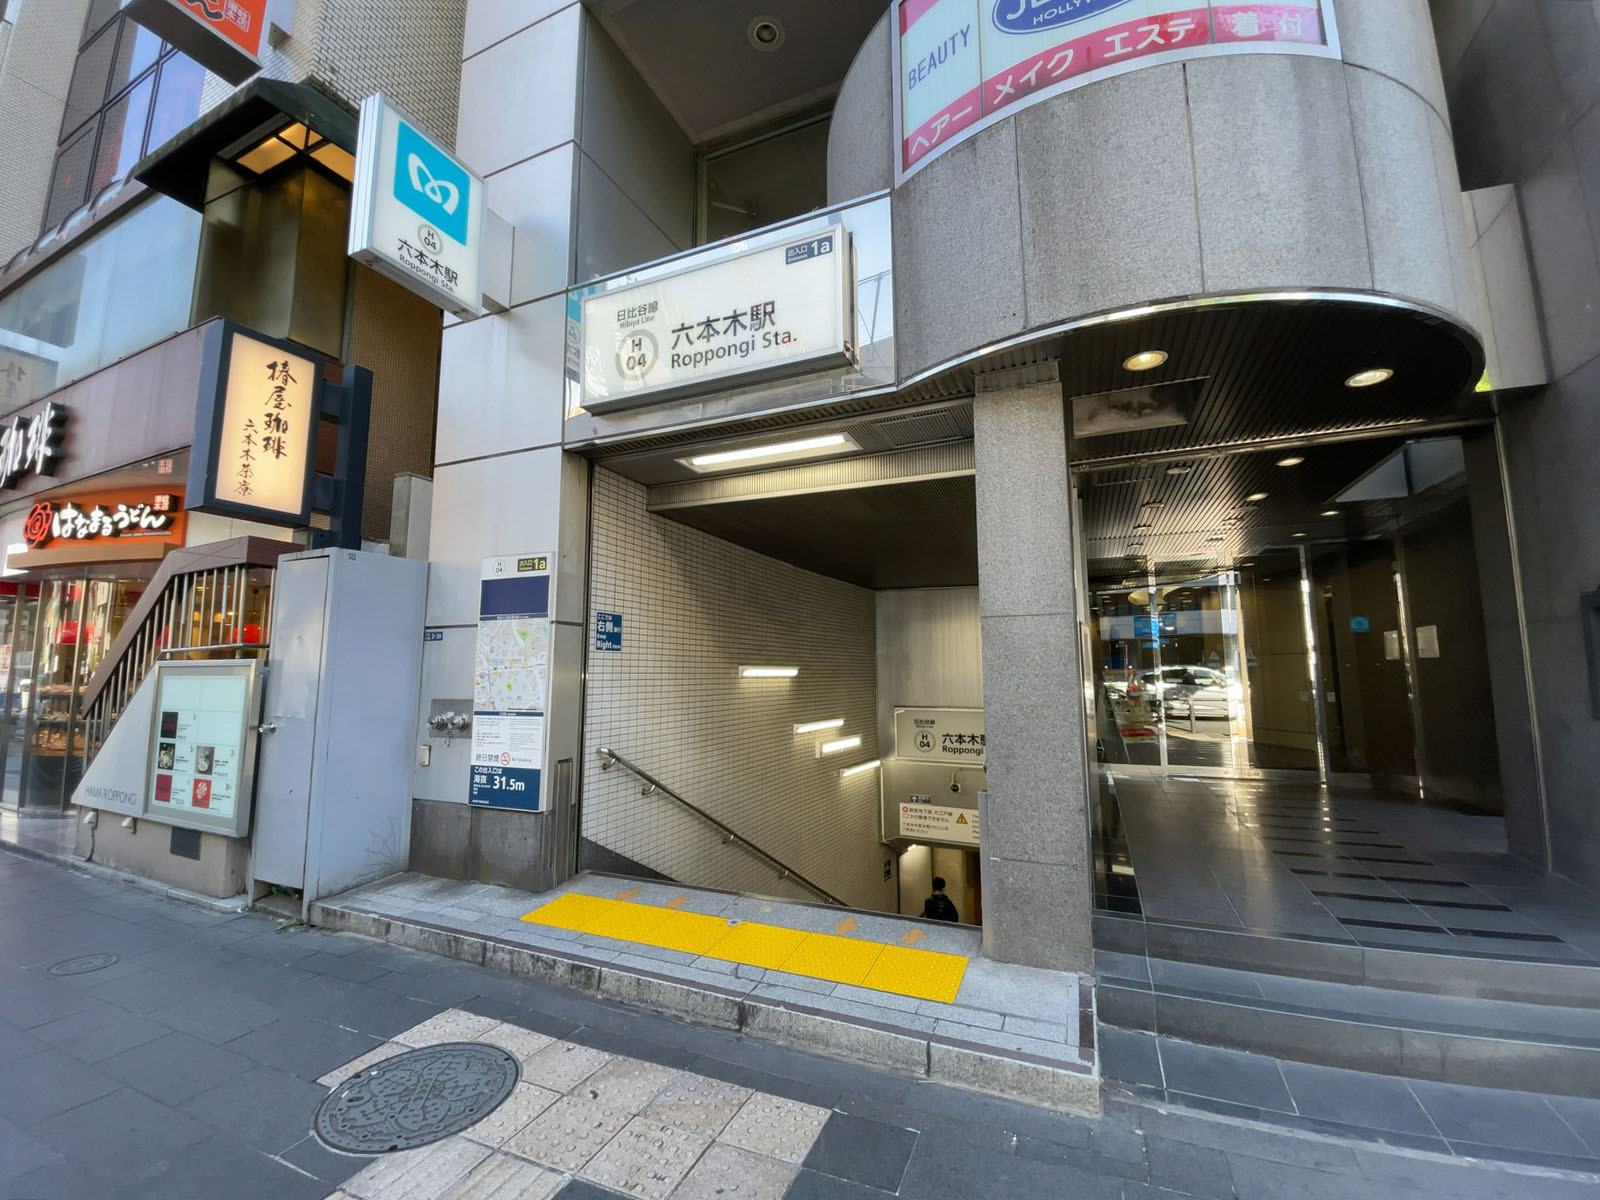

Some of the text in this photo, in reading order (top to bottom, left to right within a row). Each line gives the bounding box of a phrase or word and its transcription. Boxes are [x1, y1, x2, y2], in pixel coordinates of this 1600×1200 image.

[908, 23, 972, 91] BEAUTY
[910, 105, 973, 155] ヘアー
[993, 48, 1074, 105] メイク
[1103, 18, 1195, 58] エステ
[427, 229, 435, 240] H
[423, 236, 437, 251] 04
[810, 240, 830, 256] 1a
[397, 237, 459, 287] 六本木駅
[399, 254, 456, 294] Roppongi Sta.
[616, 300, 659, 322] 日比谷線
[619, 315, 655, 329] Hibiya Line
[671, 300, 777, 351] 六本木駅
[631, 338, 643, 352] H
[670, 329, 798, 370] Roppongi Sta.
[626, 351, 648, 371] 04
[262, 359, 298, 460] 椿屋珈琲
[51, 501, 166, 539] はなまるうどん
[533, 558, 546, 570] 1a
[596, 639, 612, 650] Right
[919, 740, 931, 749] 04
[921, 733, 928, 741] H
[941, 745, 984, 757] Roppongi
[492, 775, 526, 792] 31.5m
